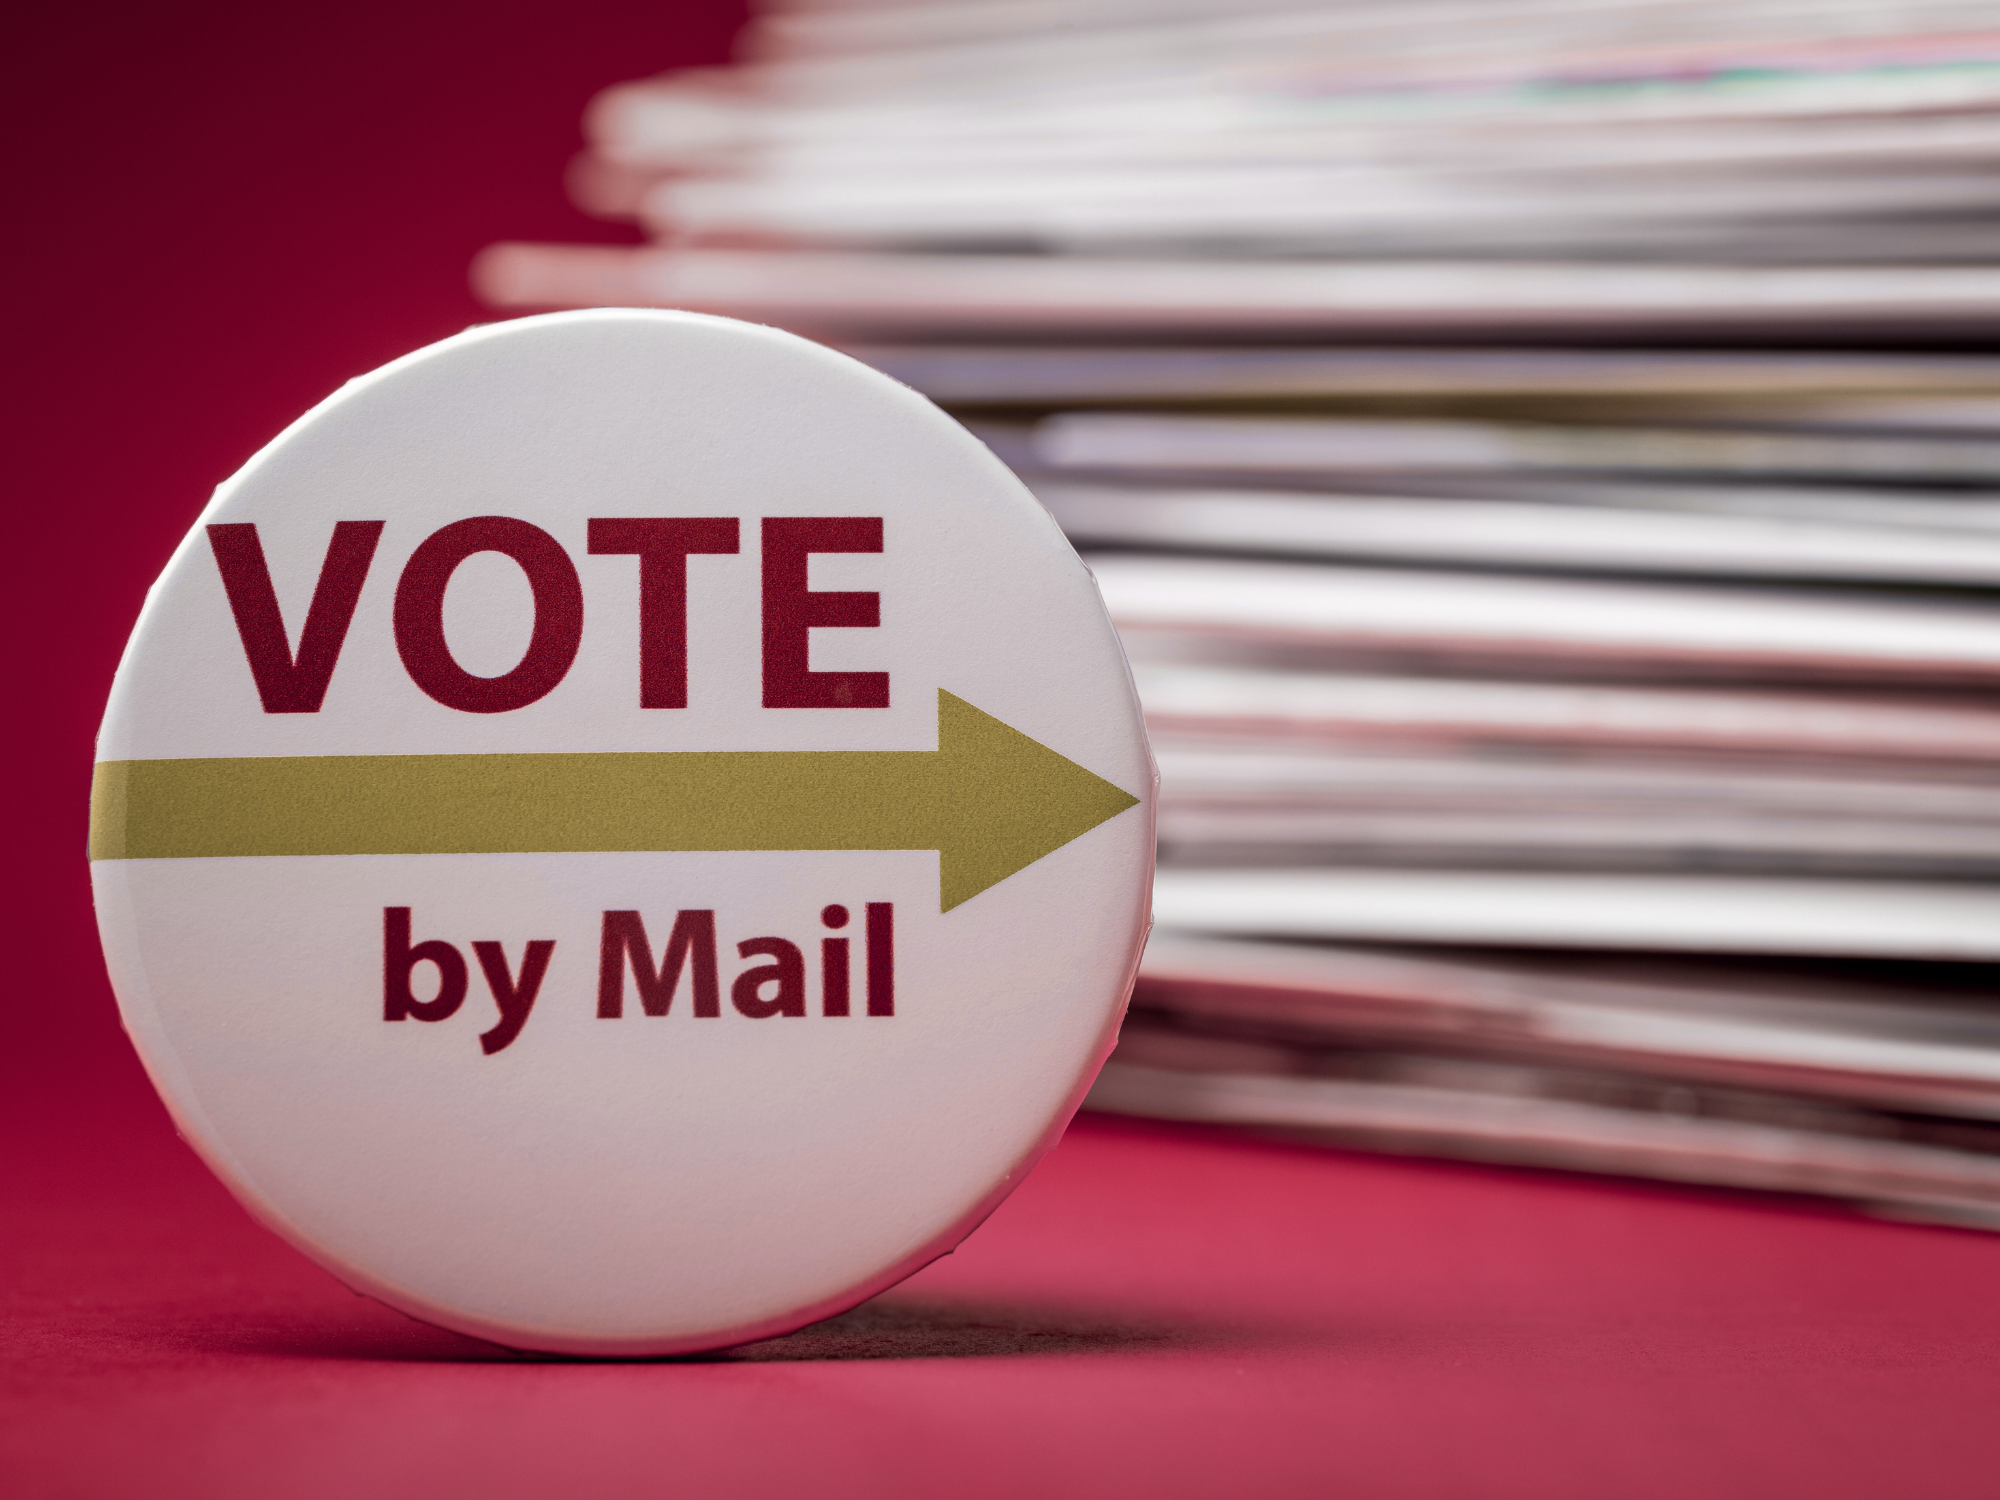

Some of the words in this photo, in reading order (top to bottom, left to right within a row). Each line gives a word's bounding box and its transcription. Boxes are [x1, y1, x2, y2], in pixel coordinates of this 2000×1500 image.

[206, 516, 890, 714] VOTE
[383, 906, 556, 1056] by
[596, 902, 895, 1019] Mail
